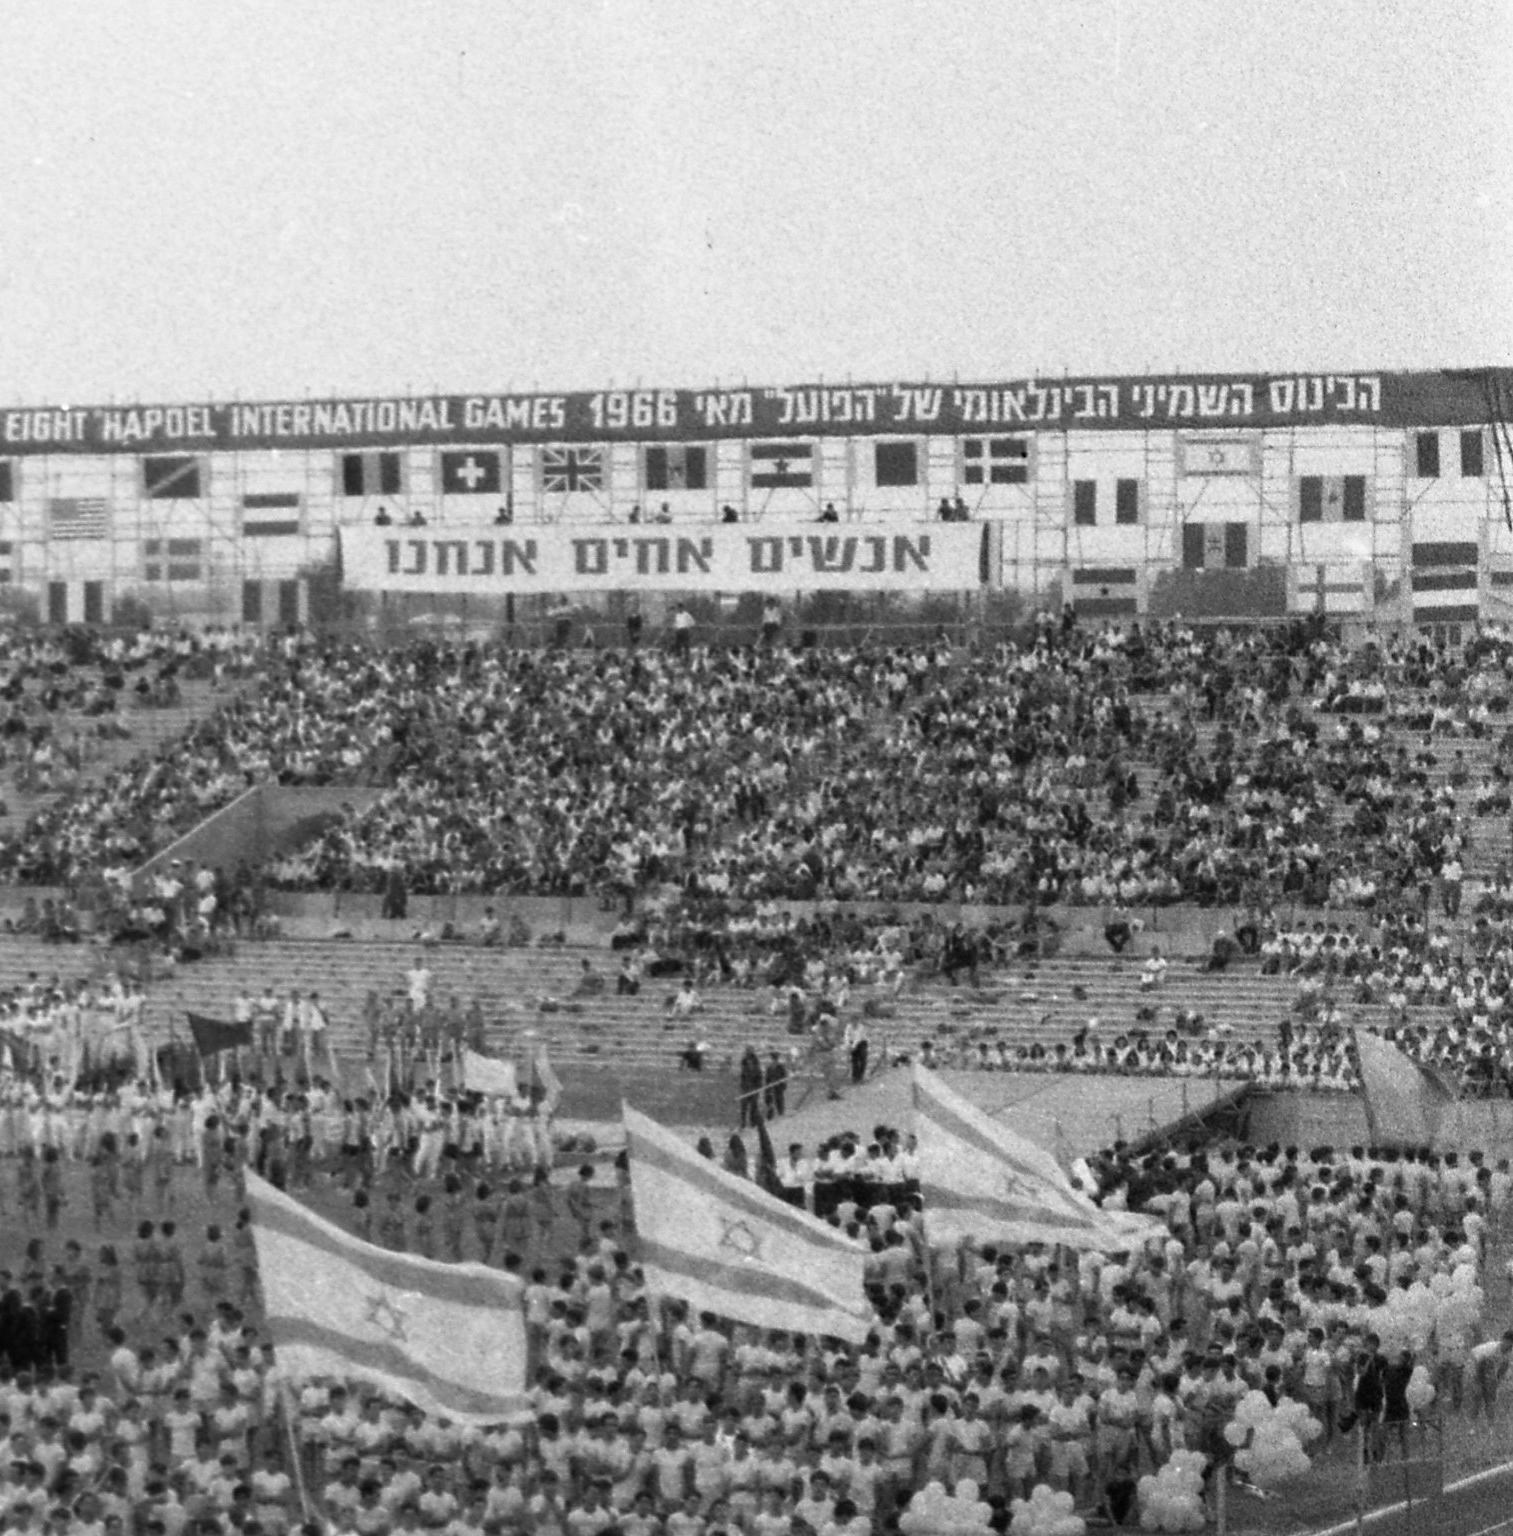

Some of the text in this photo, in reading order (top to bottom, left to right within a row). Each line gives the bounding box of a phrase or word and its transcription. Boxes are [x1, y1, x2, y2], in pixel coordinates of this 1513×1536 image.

[695, 392, 753, 426] מאי
[892, 383, 944, 421] של
[953, 380, 1120, 422] הבינלאומי
[1131, 383, 1254, 418] השמיני
[1269, 375, 1382, 413] הכינוס
[5, 410, 87, 441] EIGHT
[230, 399, 455, 438] INTERNATIONAL
[464, 397, 566, 429] GAMES
[589, 392, 677, 428] 1966
[383, 535, 932, 576] אנשים אחים אנחנו
